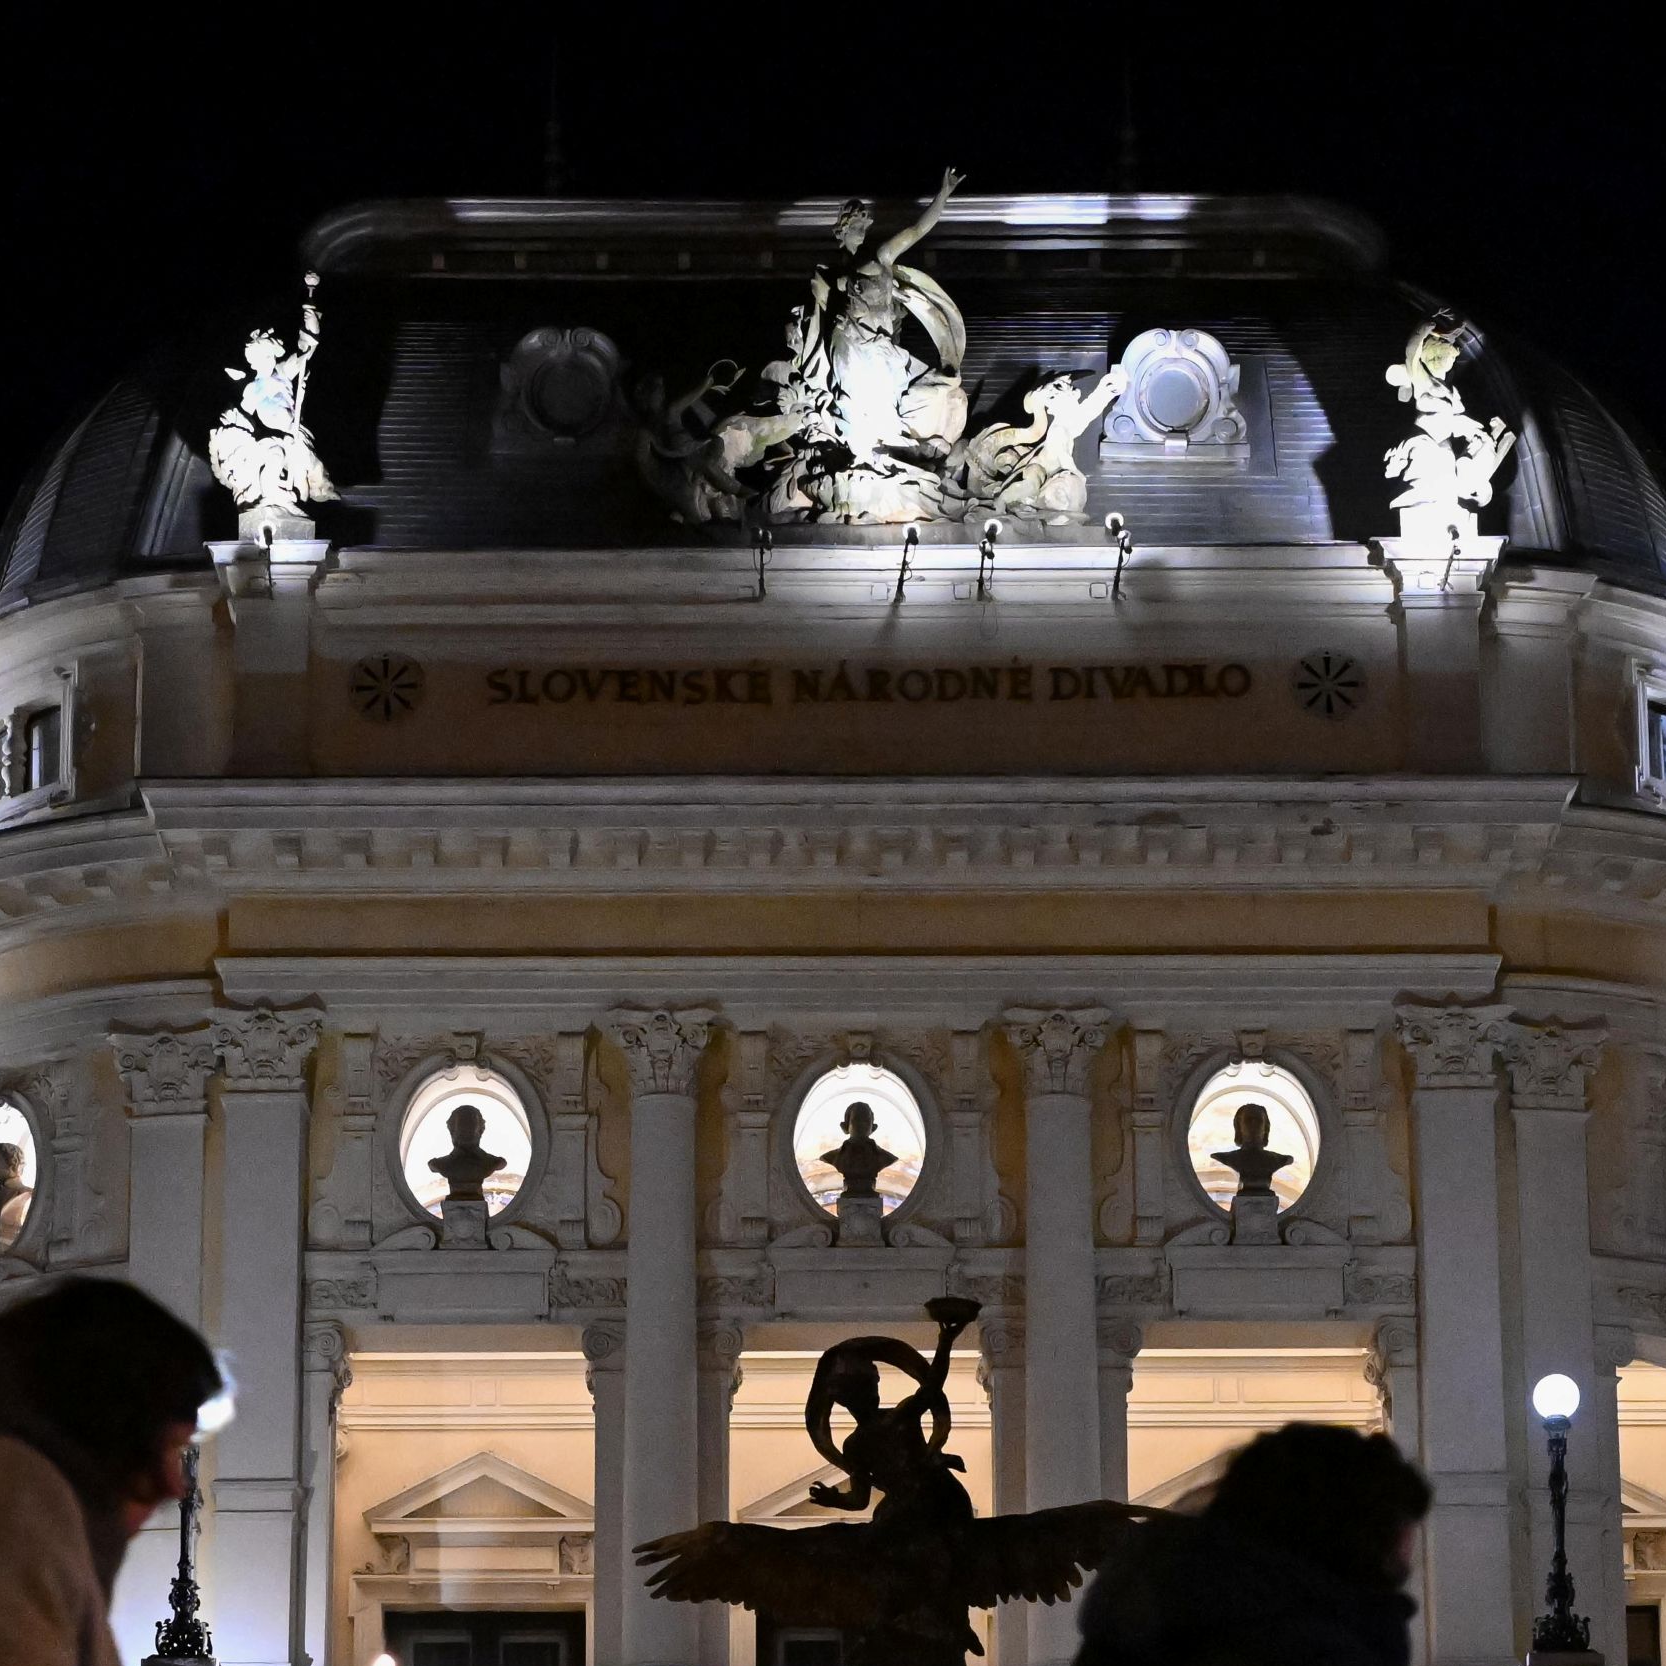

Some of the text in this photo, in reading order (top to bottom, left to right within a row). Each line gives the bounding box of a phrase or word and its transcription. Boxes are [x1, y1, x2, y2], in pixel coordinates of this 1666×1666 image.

[485, 656, 1252, 706] SLOVENSKÉ NÁRODNÉ DIVADLO
